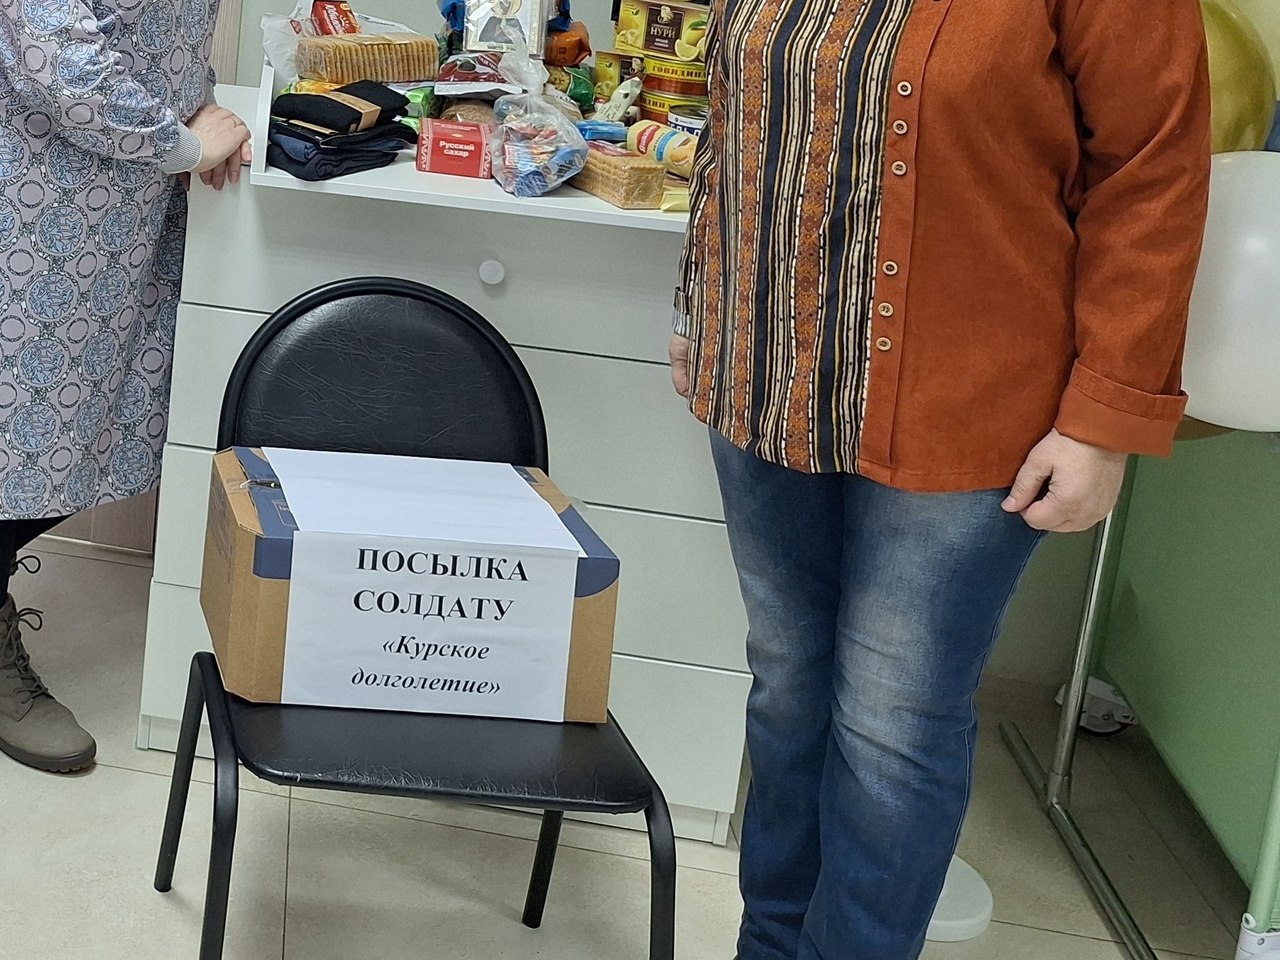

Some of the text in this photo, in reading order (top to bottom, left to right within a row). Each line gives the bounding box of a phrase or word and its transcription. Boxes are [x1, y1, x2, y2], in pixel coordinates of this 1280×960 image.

[650, 26, 676, 39] НУРИ
[439, 140, 475, 151] Русский
[443, 149, 469, 158] сахар
[356, 548, 529, 582] ПОСЫЛКА
[353, 589, 515, 621] СОЛДАТУ
[381, 635, 490, 660] «Курское
[351, 667, 501, 694] долголетие»
